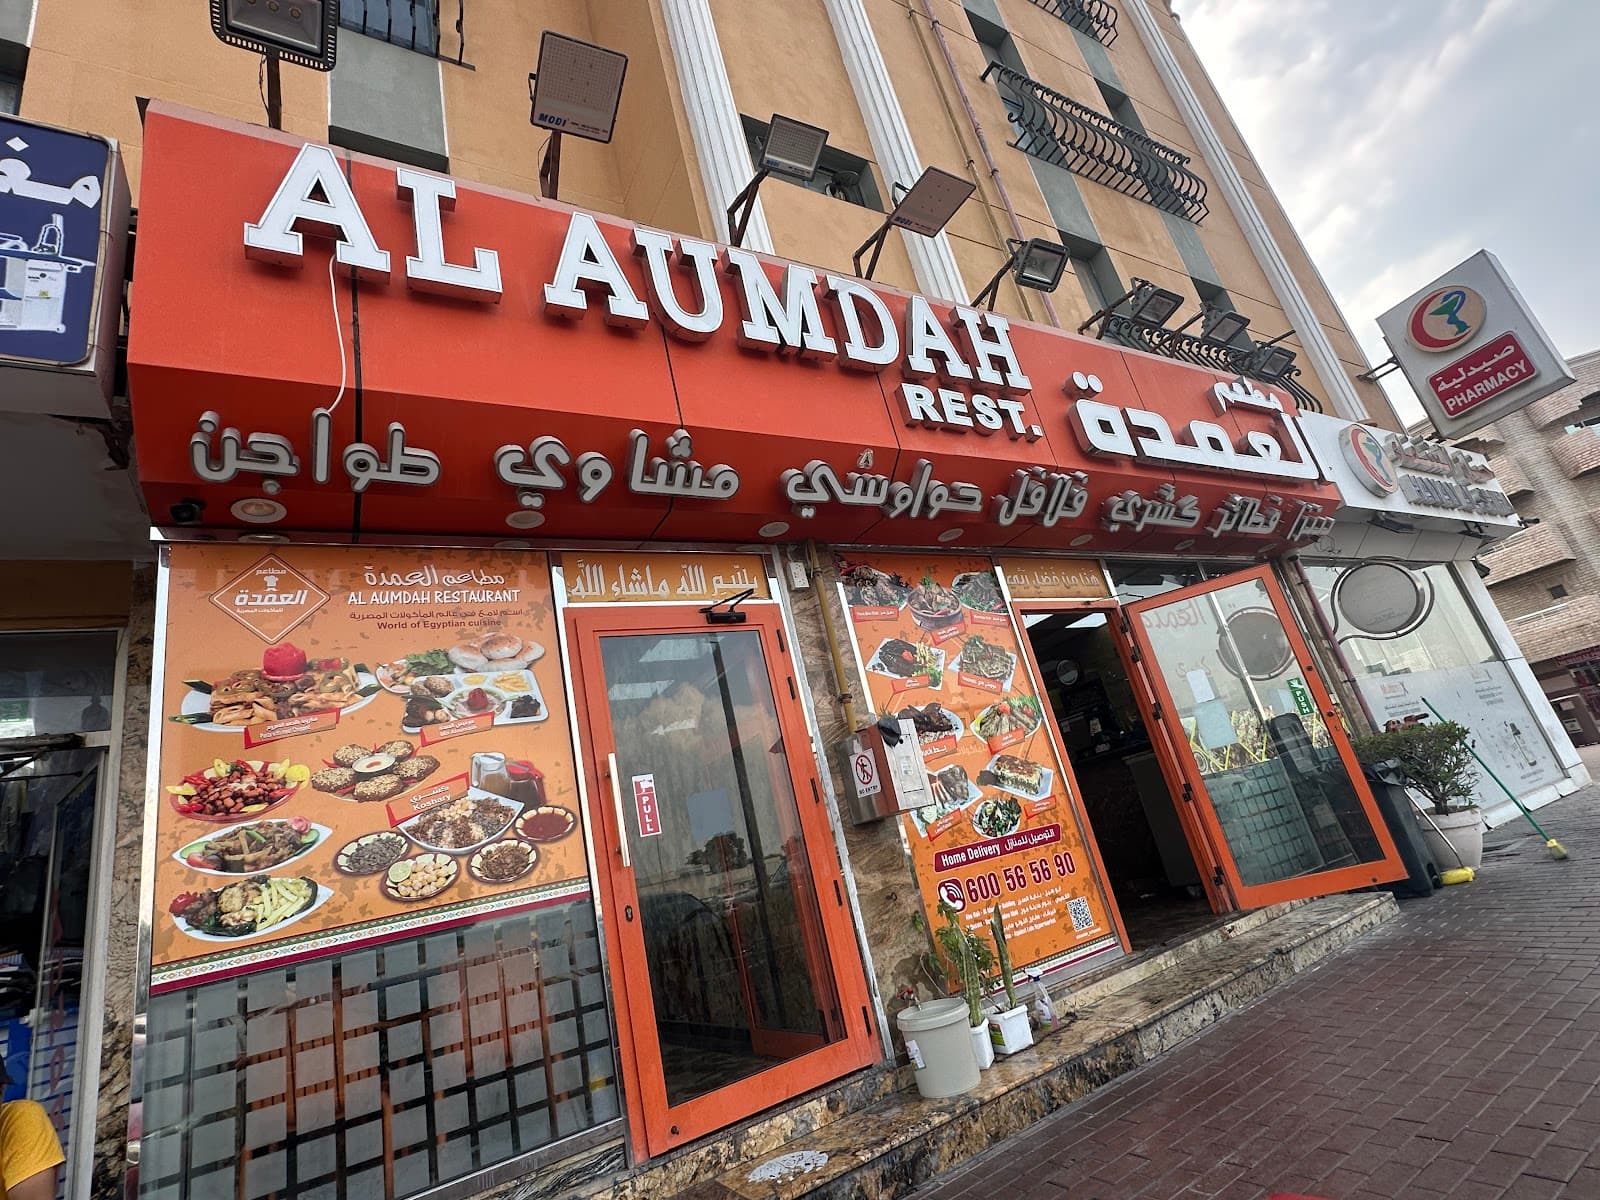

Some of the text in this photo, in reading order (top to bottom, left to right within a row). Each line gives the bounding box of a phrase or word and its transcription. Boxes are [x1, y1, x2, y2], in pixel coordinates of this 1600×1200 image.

[243, 142, 1032, 391] AL AUMDAH
[1436, 345, 1515, 392] صيدلية
[1445, 360, 1527, 411] PHARMACY
[901, 382, 1044, 438] REST.
[1072, 371, 1335, 481] العمدة
[363, 564, 505, 586] مطاعم العمدة
[347, 589, 521, 605] AL AUMDAH RESTAURANT
[377, 619, 501, 630] World of Egyptian cuisine
[1295, 690, 1310, 713] PUSH
[413, 793, 452, 811] Koshary
[641, 795, 654, 832] PULL
[941, 843, 1001, 867] Home Delivery
[965, 852, 1076, 903] 600 56 56 90
